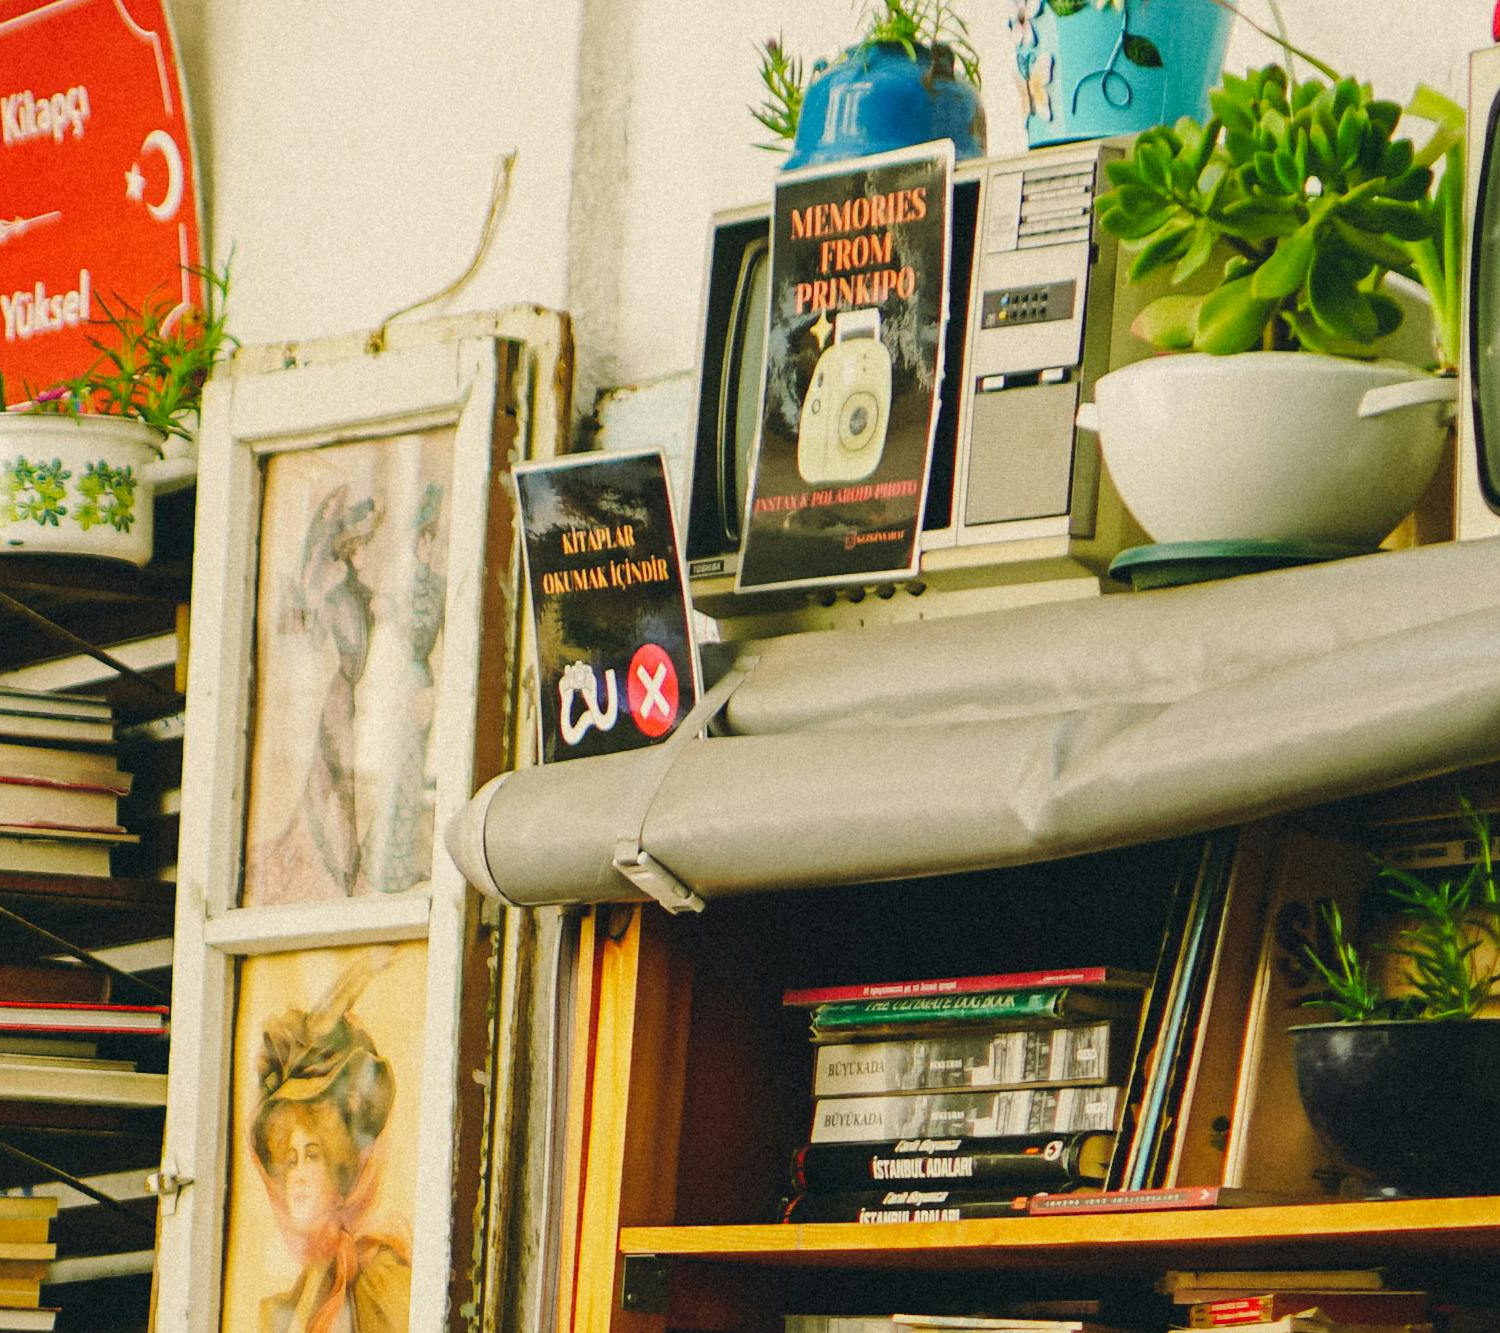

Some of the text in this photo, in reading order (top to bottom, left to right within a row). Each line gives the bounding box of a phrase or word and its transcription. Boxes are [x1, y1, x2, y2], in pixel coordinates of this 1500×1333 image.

[0, 85, 91, 146] Kitapçı
[790, 186, 928, 241] MEMORIES
[820, 231, 895, 275] FROM
[0, 267, 91, 342] Yüksel
[794, 265, 916, 316] PRINKIPO
[562, 524, 636, 555] KİTAPLAR
[542, 554, 670, 595] OKUMAK İÇİNDİR
[823, 1109, 884, 1129] BÜYÜKADA
[872, 1155, 973, 1180] İSTANBUL ADALARI
